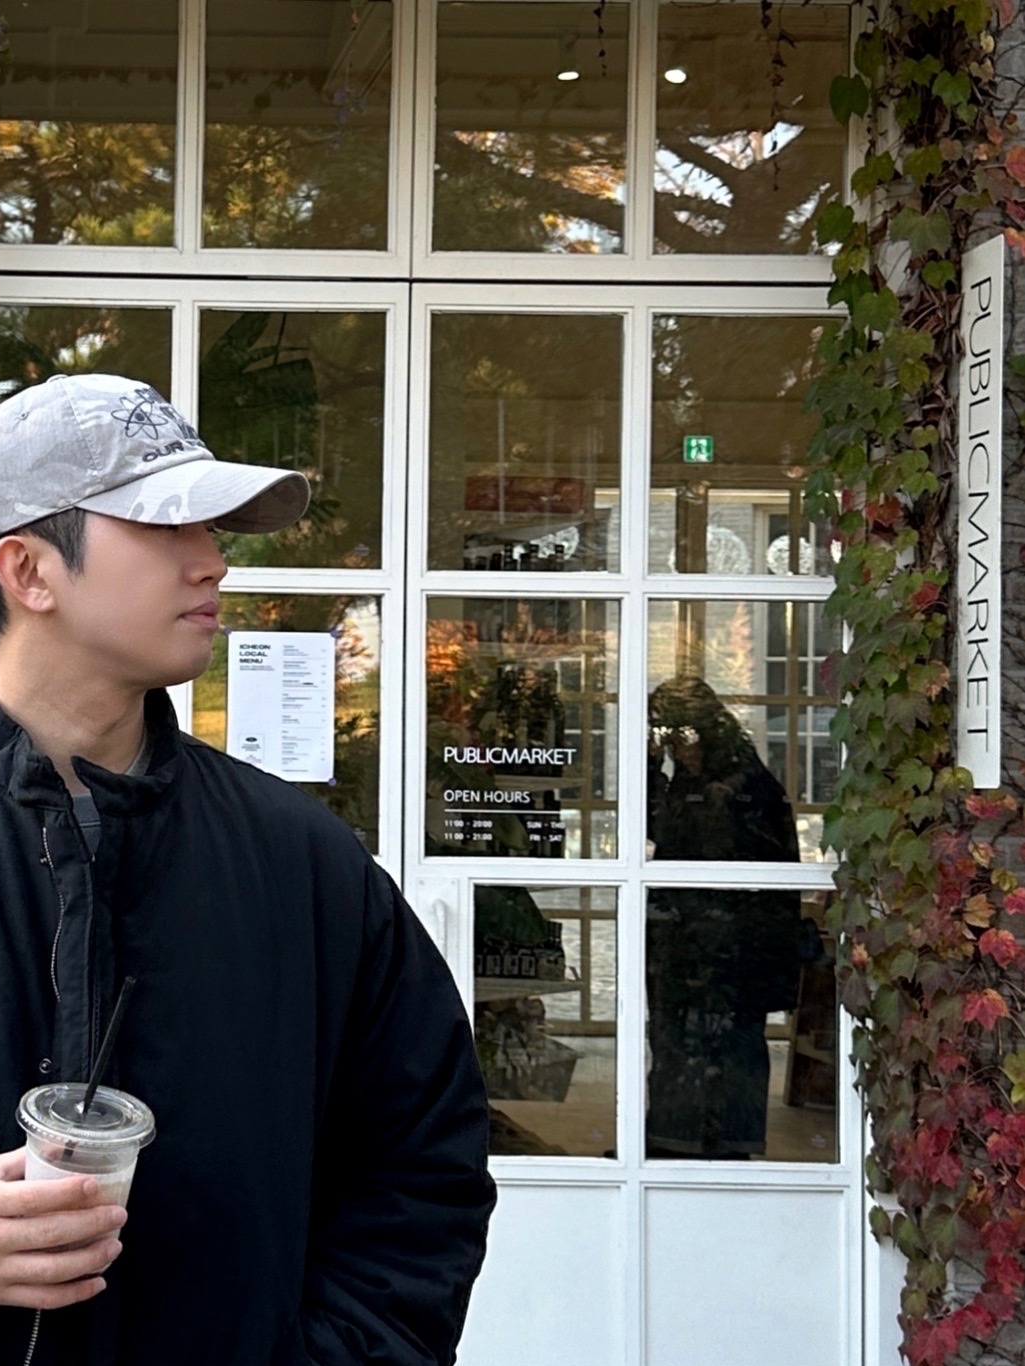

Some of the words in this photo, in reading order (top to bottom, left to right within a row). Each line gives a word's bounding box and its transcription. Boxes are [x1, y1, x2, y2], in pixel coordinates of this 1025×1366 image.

[966, 276, 992, 753] PUBLICMARKET
[443, 746, 577, 765] PUBLICMARKET
[443, 789, 480, 802] OPEN
[484, 790, 531, 803] HOURS
[526, 821, 542, 829] SUN
[549, 834, 563, 842] SAT
